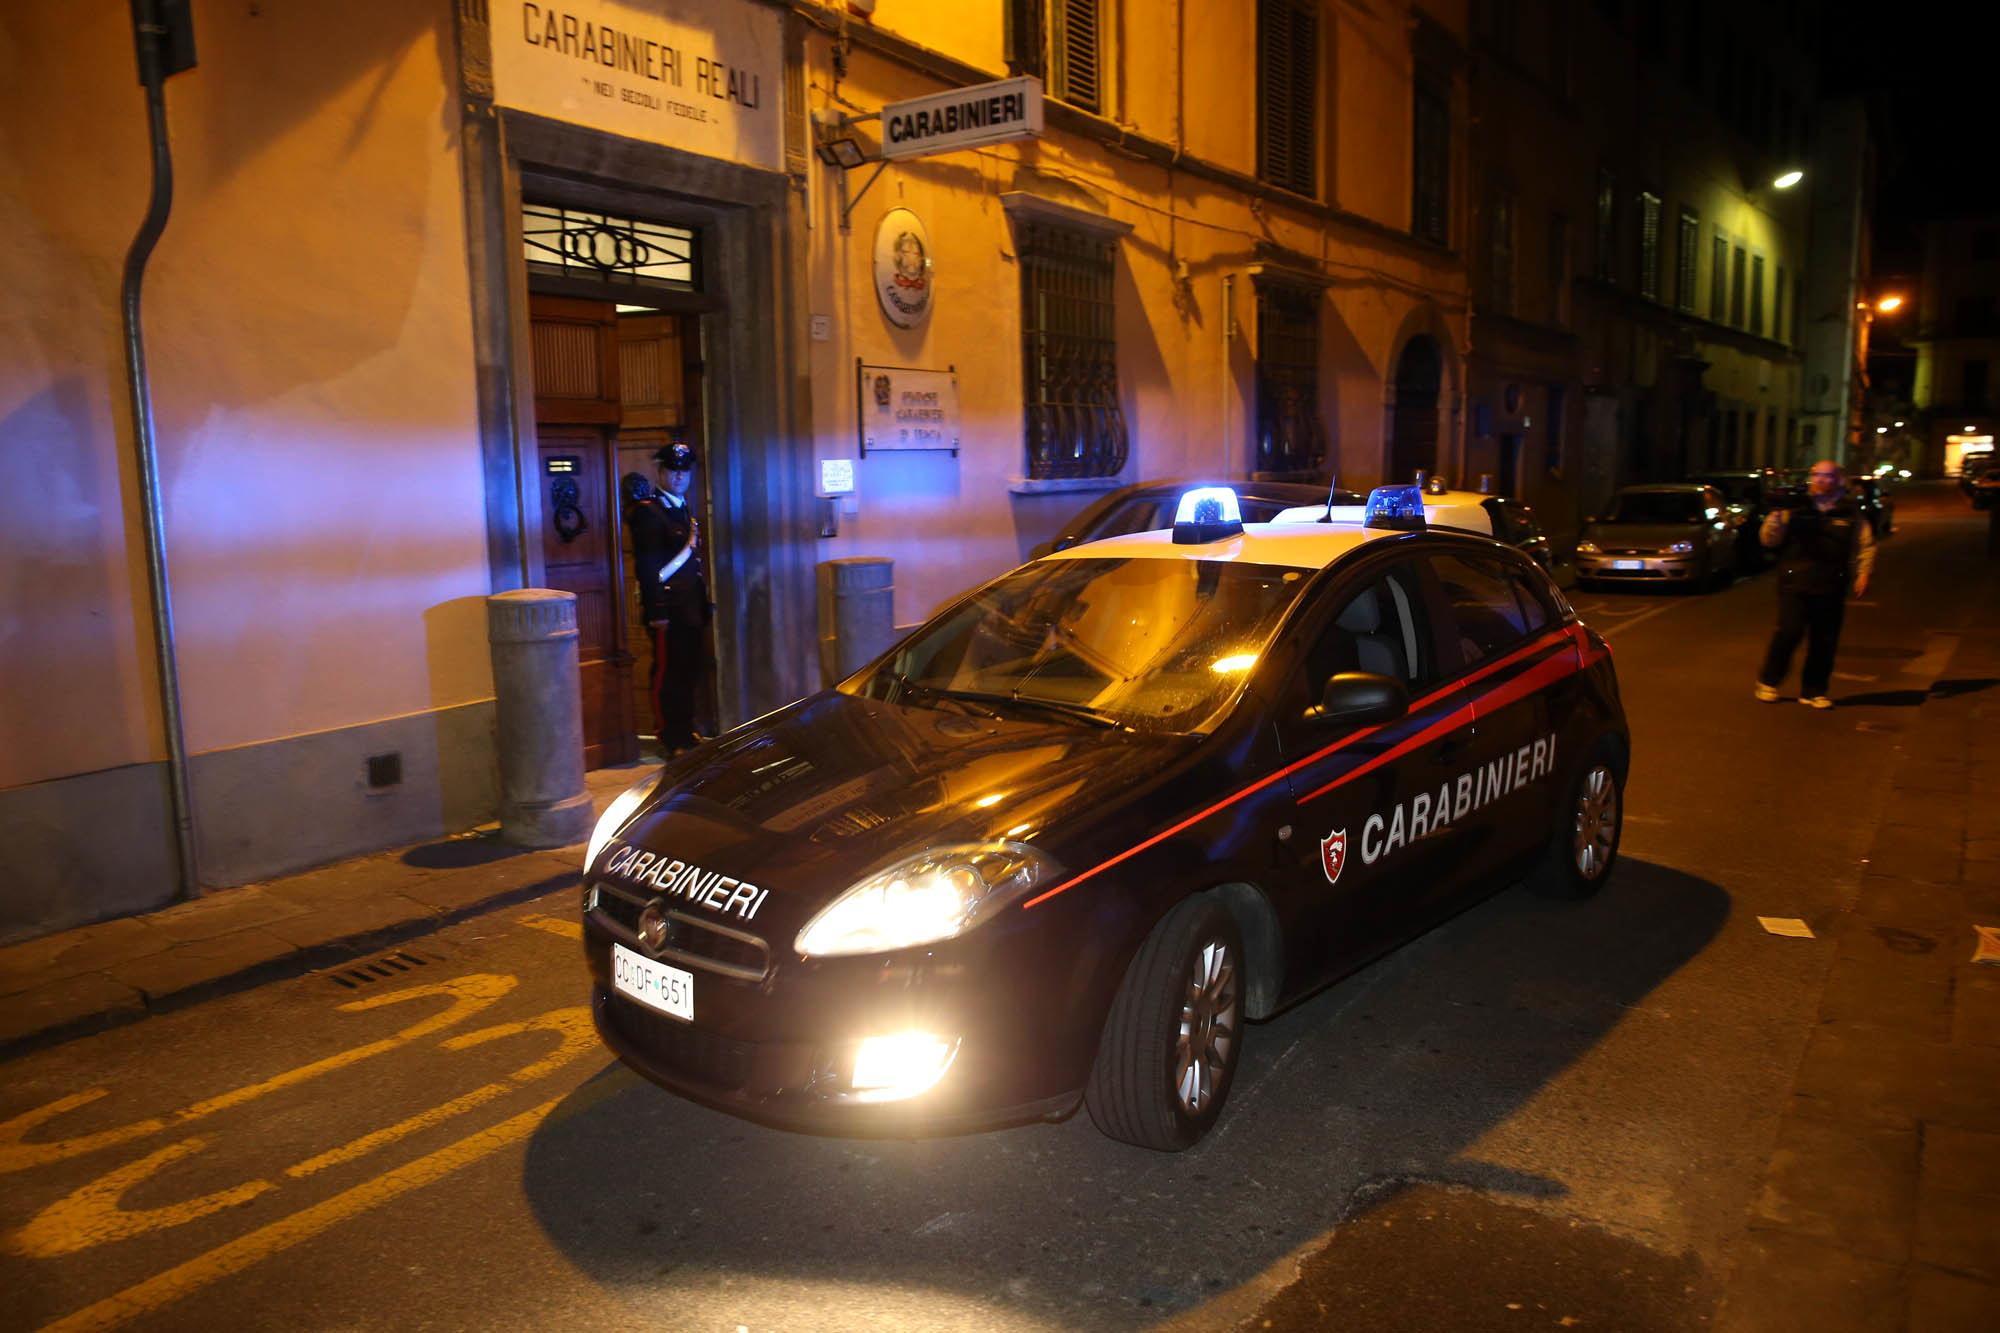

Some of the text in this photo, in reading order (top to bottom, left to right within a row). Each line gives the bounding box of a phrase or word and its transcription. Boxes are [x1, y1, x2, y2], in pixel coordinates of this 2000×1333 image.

[523, 2, 759, 109] CARABINIERI REALI
[889, 92, 1024, 143] CARABINIERI
[1361, 733, 1556, 865] CARABINIERI
[604, 845, 769, 920] CARABINIERI
[636, 965, 652, 994] DF
[661, 975, 687, 1009] 651
